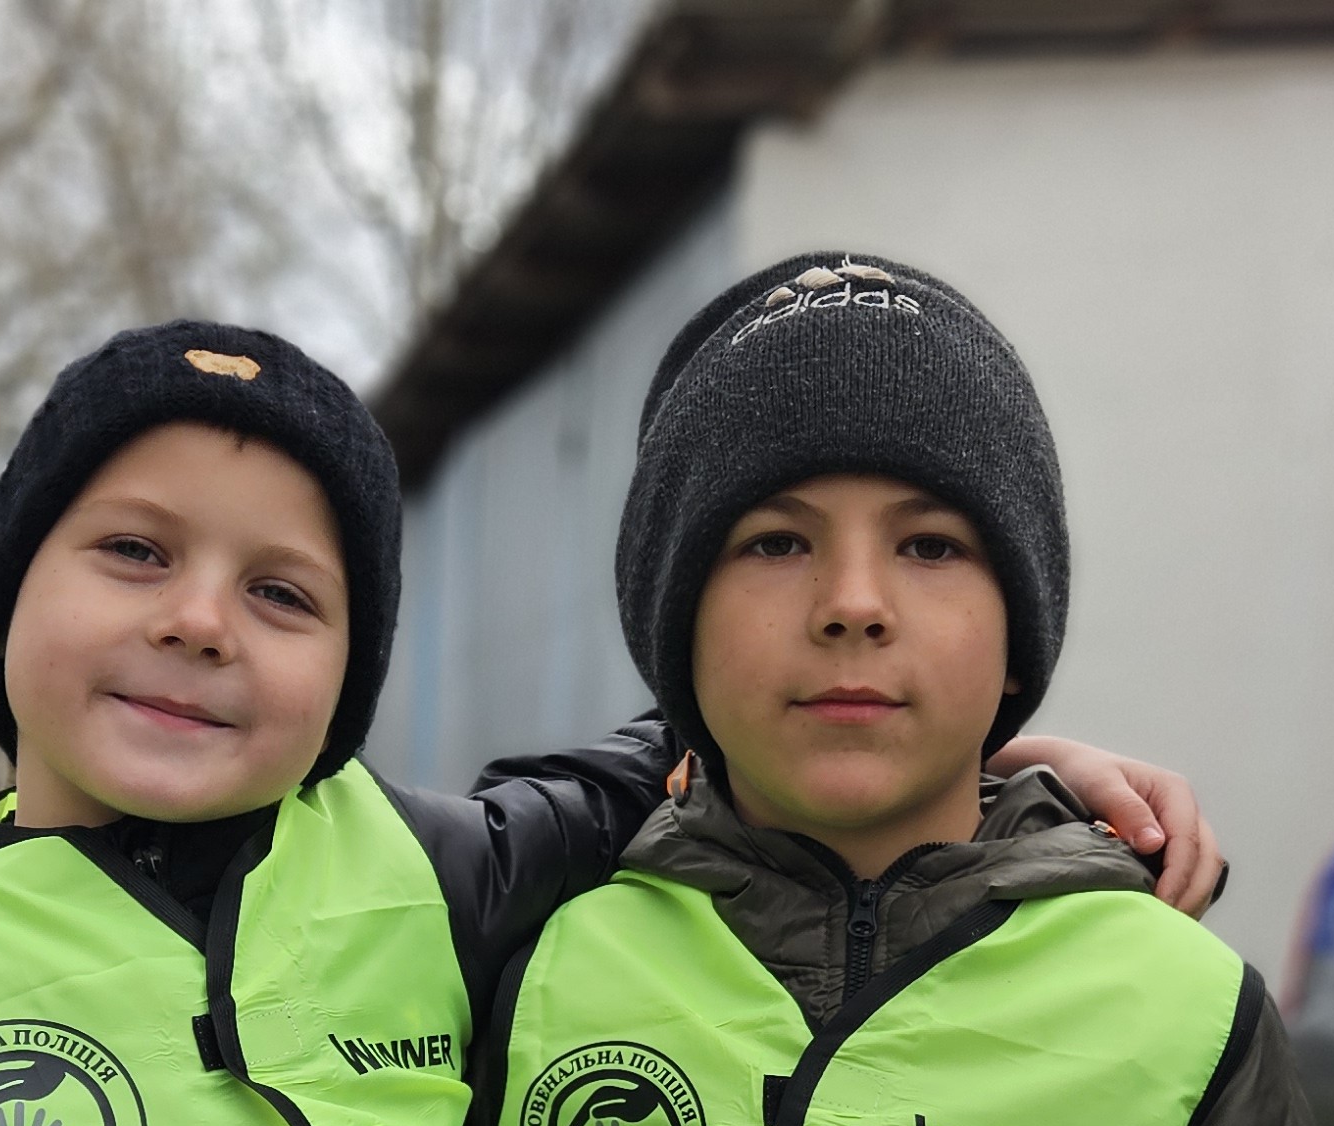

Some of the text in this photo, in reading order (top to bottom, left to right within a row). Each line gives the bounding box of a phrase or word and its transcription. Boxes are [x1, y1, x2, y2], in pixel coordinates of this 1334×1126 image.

[13, 1030, 118, 1083] ПОЛІЦІЯ
[328, 1034, 455, 1075] WINNER
[628, 1053, 698, 1124] ПОЛІЦІЯ
